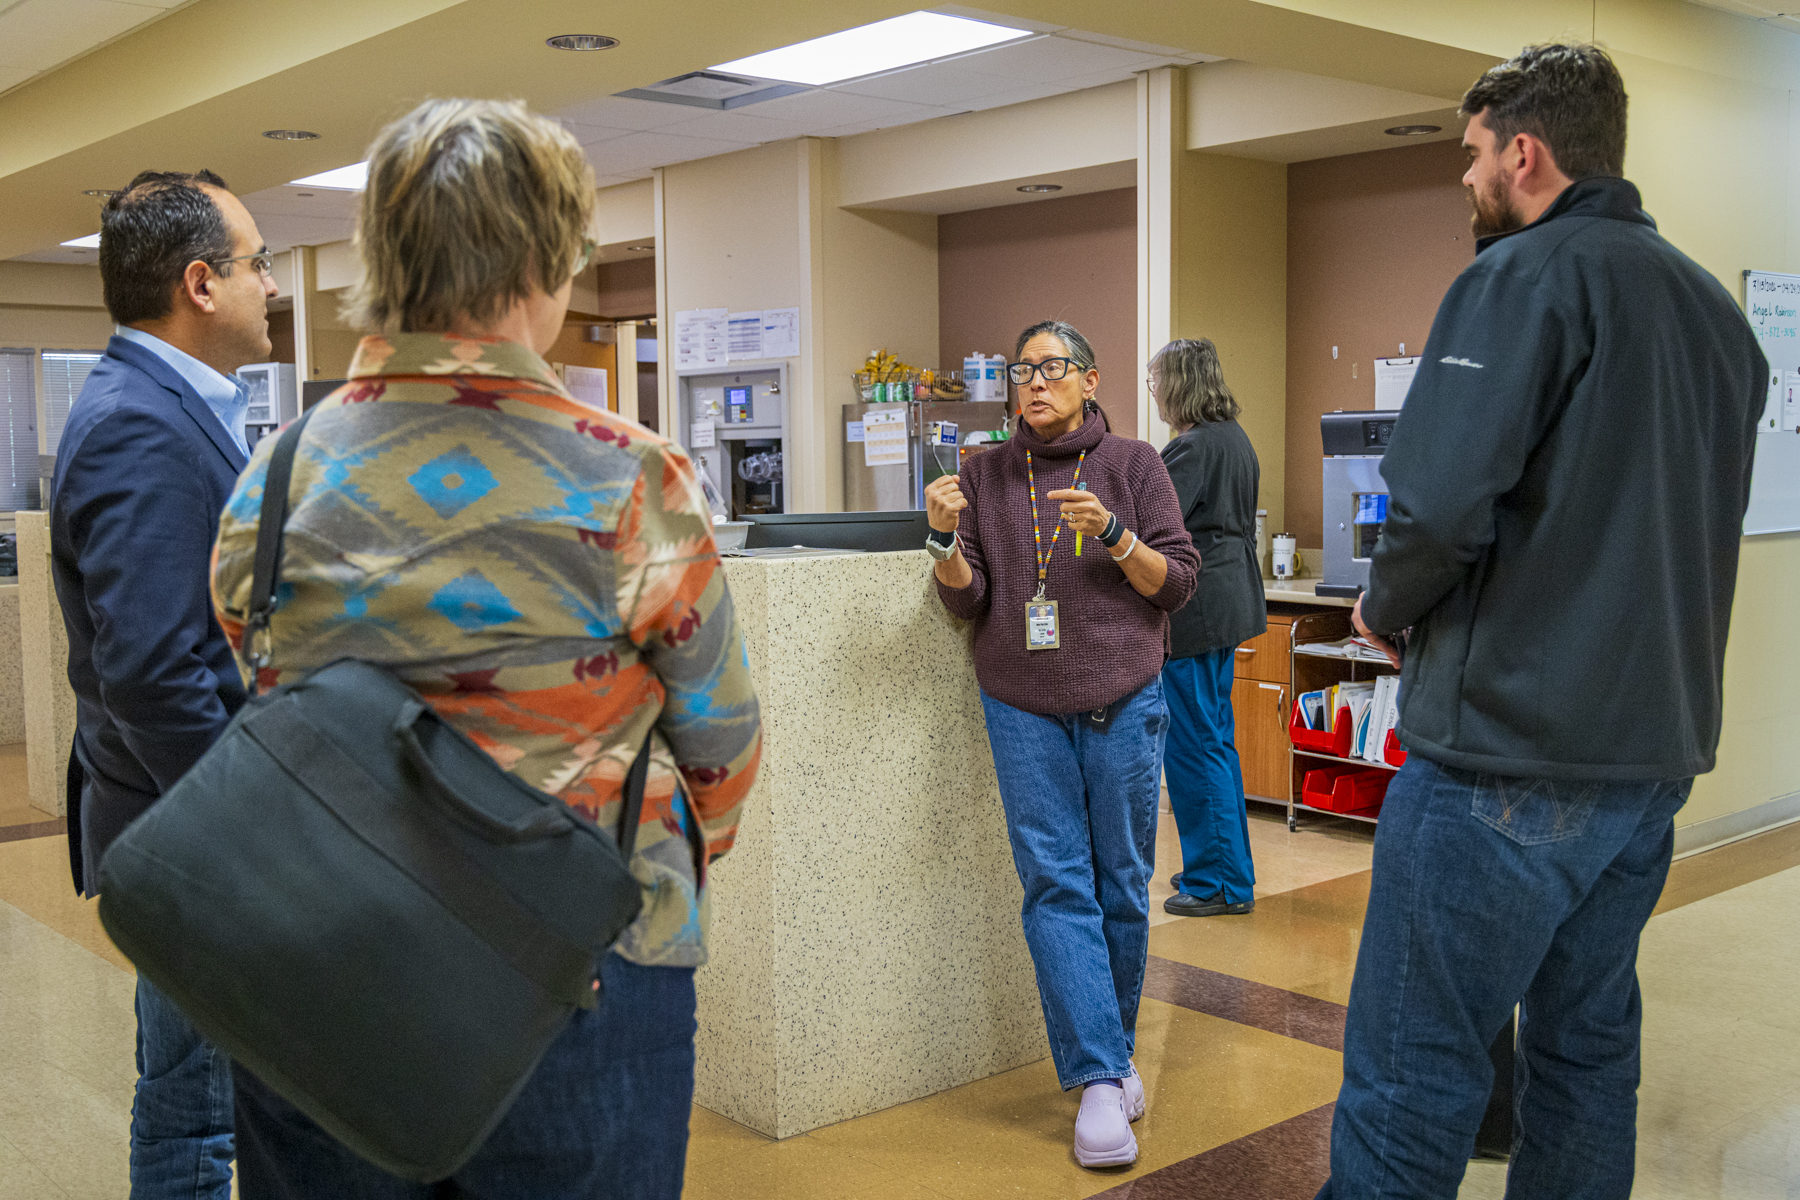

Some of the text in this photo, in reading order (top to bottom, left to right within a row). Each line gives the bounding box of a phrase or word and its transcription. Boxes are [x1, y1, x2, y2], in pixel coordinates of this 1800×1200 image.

[1752, 302, 1797, 325] Angel Robinson
[1387, 708, 1395, 730] CERNE
[1084, 1099, 1120, 1110] HUNTER
